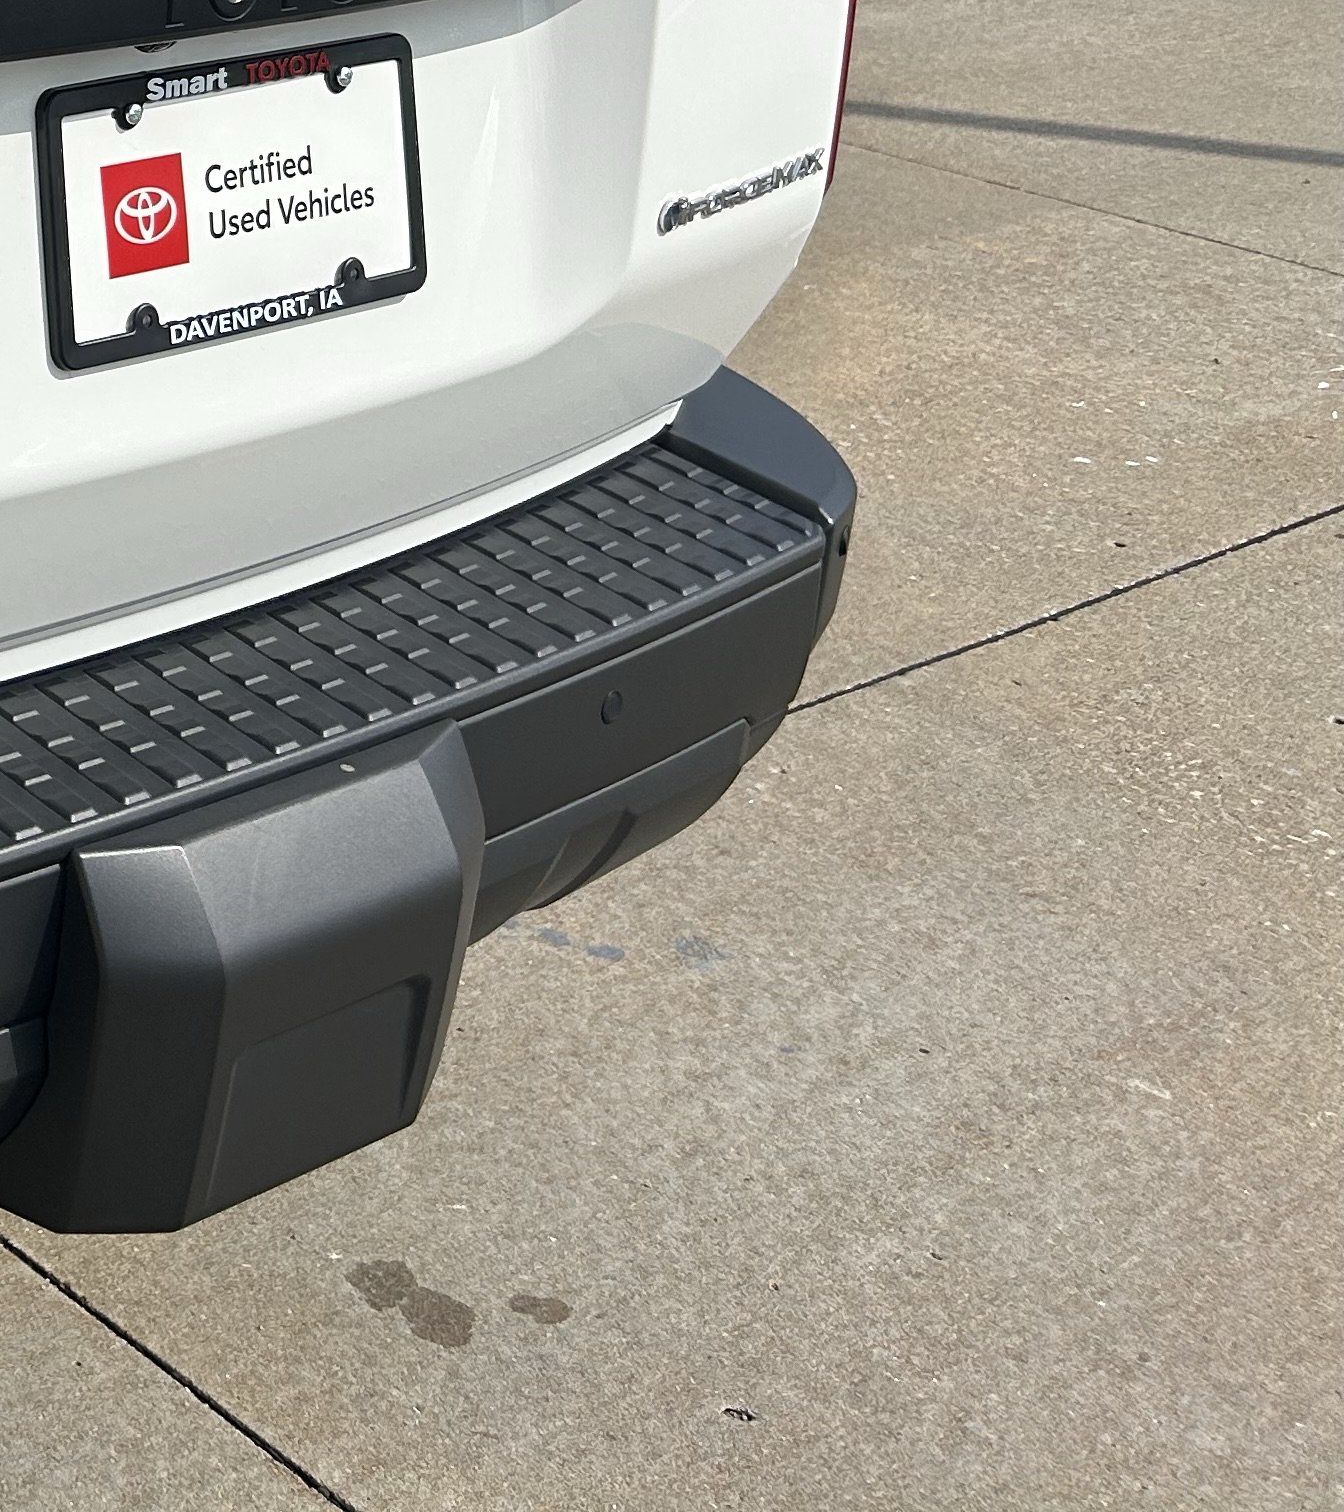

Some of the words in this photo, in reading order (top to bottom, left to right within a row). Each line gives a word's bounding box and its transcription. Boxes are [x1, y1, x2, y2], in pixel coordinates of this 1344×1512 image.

[146, 66, 229, 101] Smart
[245, 51, 332, 85] TOYOTA
[204, 145, 313, 194] Certified
[208, 200, 271, 239] Used
[277, 183, 375, 227] Vehicles
[169, 295, 316, 345] DAVENPORT,
[318, 288, 344, 308] IA
